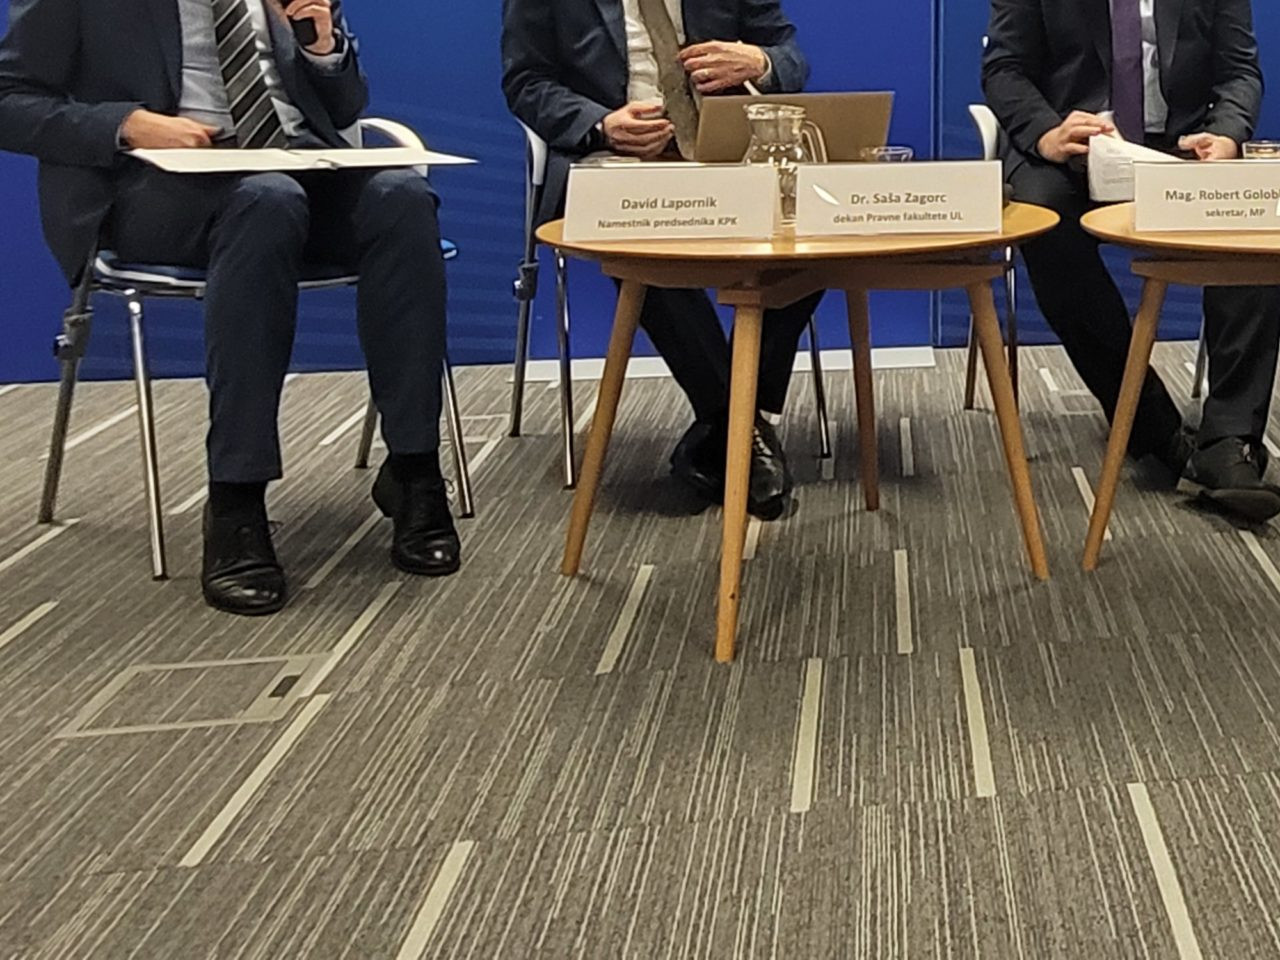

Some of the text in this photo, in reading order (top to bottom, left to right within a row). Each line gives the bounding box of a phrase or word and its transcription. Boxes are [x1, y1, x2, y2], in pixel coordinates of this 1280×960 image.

[851, 192, 947, 206] Dr. Saša Zagorc
[1165, 190, 1196, 202] Mag.
[1200, 189, 1240, 200] Robert
[621, 197, 717, 211] David Lapornik
[833, 211, 963, 224] dekan Pravne fakultete UL
[1205, 208, 1265, 218] sekretar, MP
[598, 217, 737, 229] Namestnik predsednika KPK
